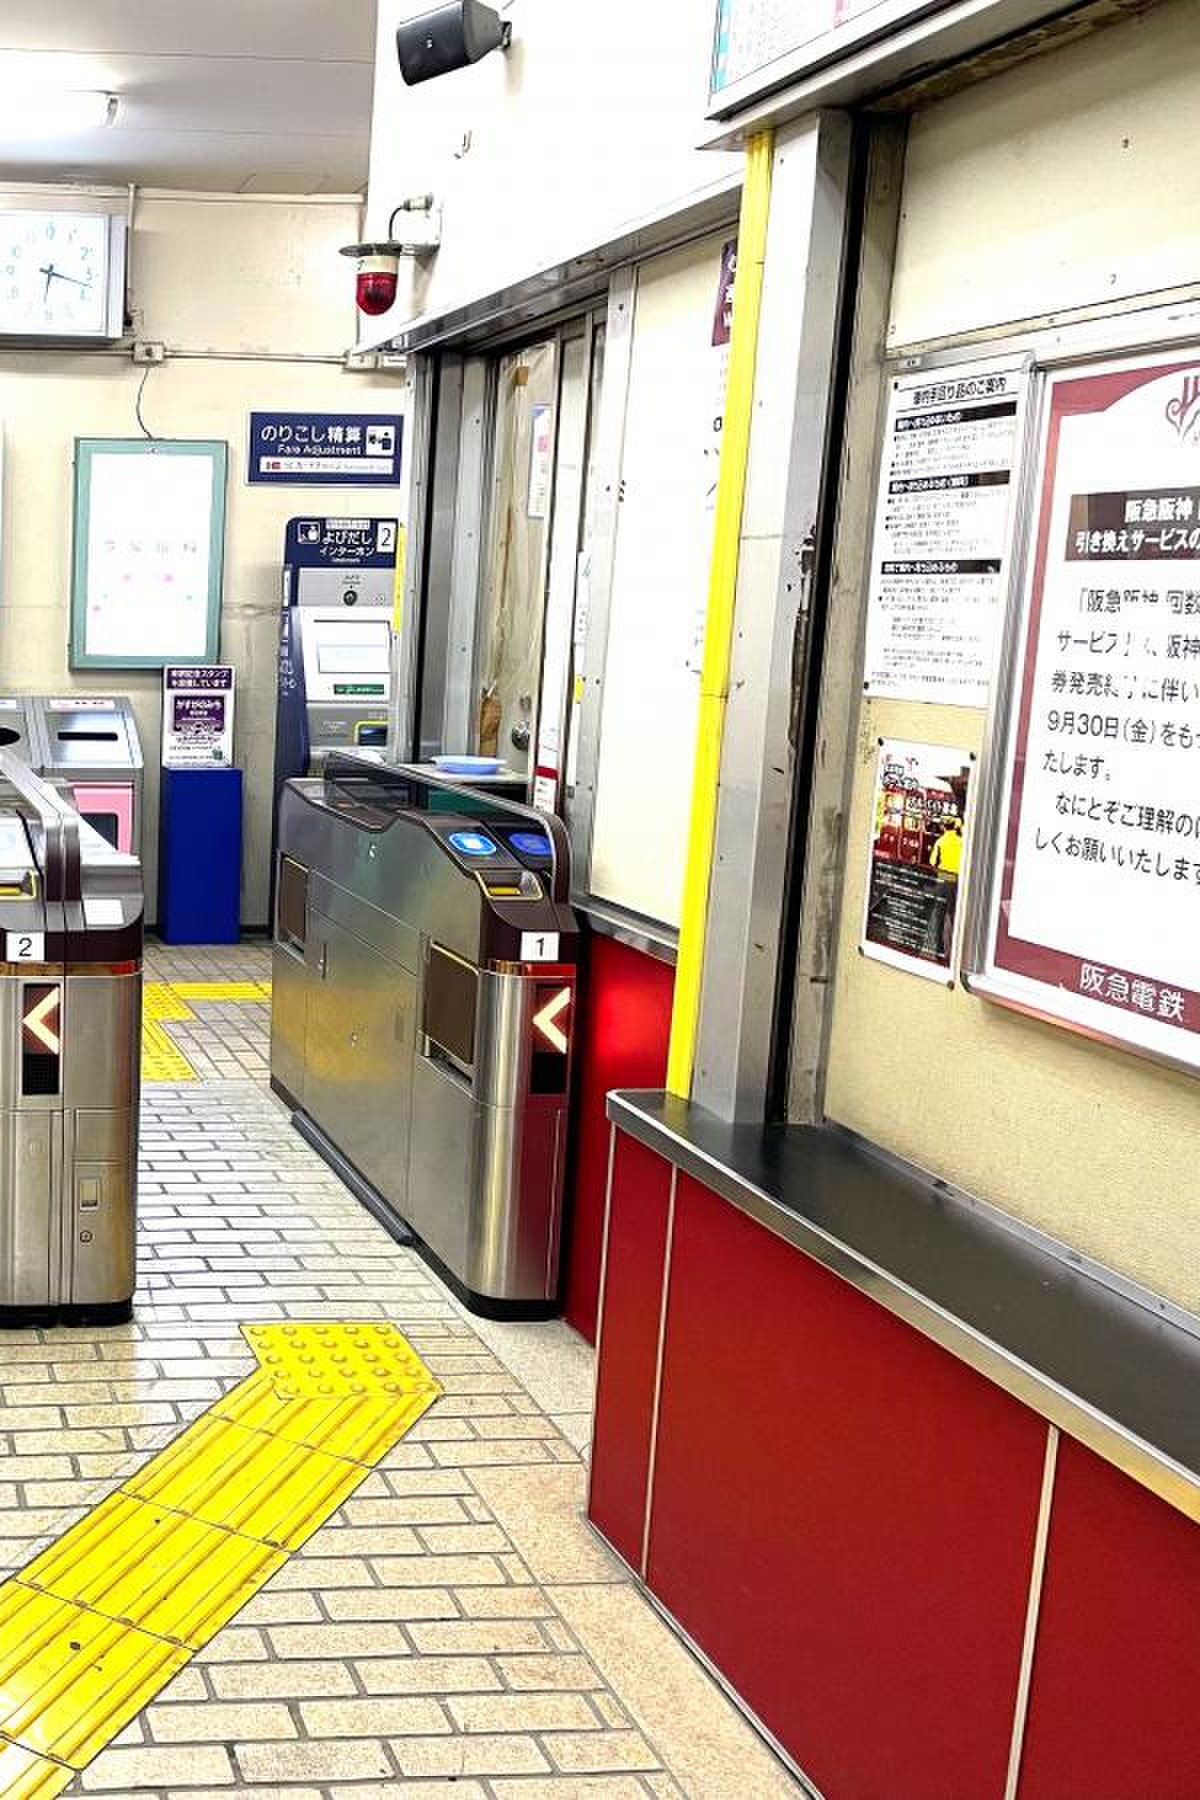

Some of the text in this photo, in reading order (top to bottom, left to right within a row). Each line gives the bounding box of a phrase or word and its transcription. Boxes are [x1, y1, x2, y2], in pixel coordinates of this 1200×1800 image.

[260, 425, 362, 443] のりこし精算
[1124, 497, 1193, 524] 阪急阪神
[322, 530, 372, 545] よびだし
[381, 527, 391, 546] 2
[1047, 709, 1200, 749] 9月30日(金)をも
[18, 937, 33, 957] 2
[535, 938, 545, 957] 1
[1079, 962, 1186, 1023] 阪急電鉄
